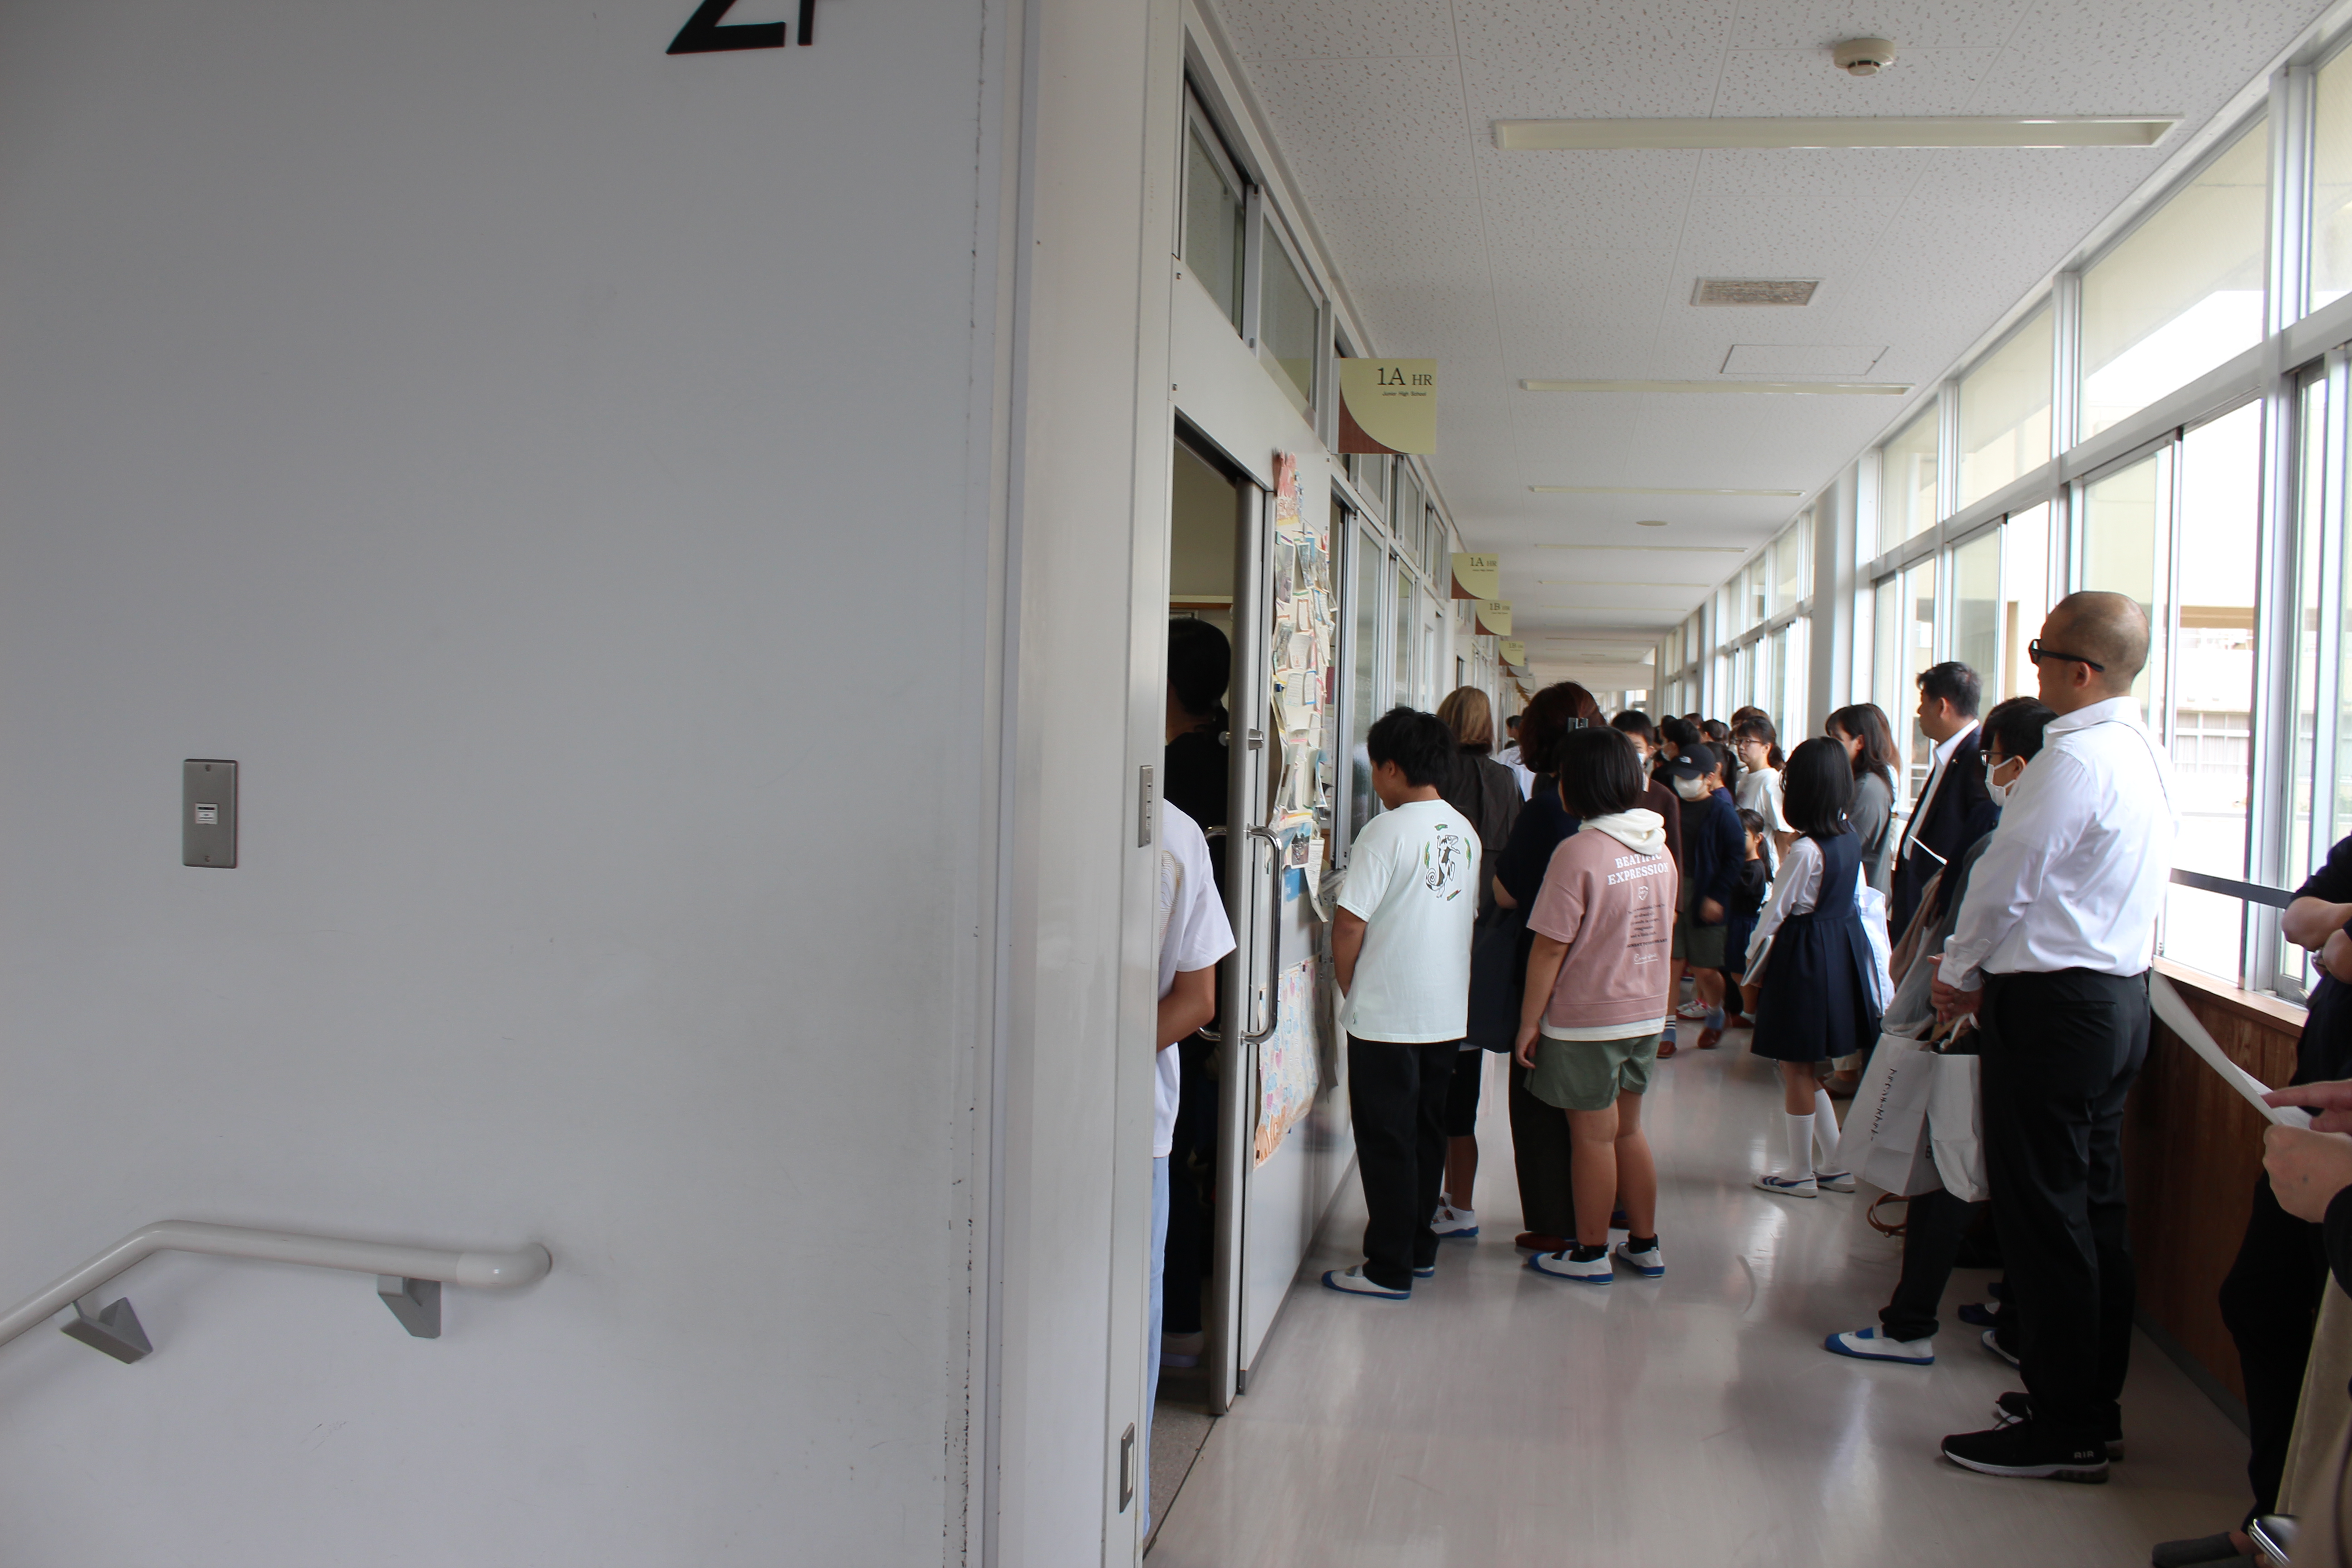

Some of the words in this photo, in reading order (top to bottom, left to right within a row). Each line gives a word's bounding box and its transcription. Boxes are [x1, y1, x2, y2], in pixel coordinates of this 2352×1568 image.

[1377, 367, 1406, 385] 1A
[1412, 374, 1432, 386] HR
[1470, 557, 1484, 566] 1A
[1607, 862, 1669, 885] EXPRESSION
[2074, 1450, 2094, 1459] AIR
